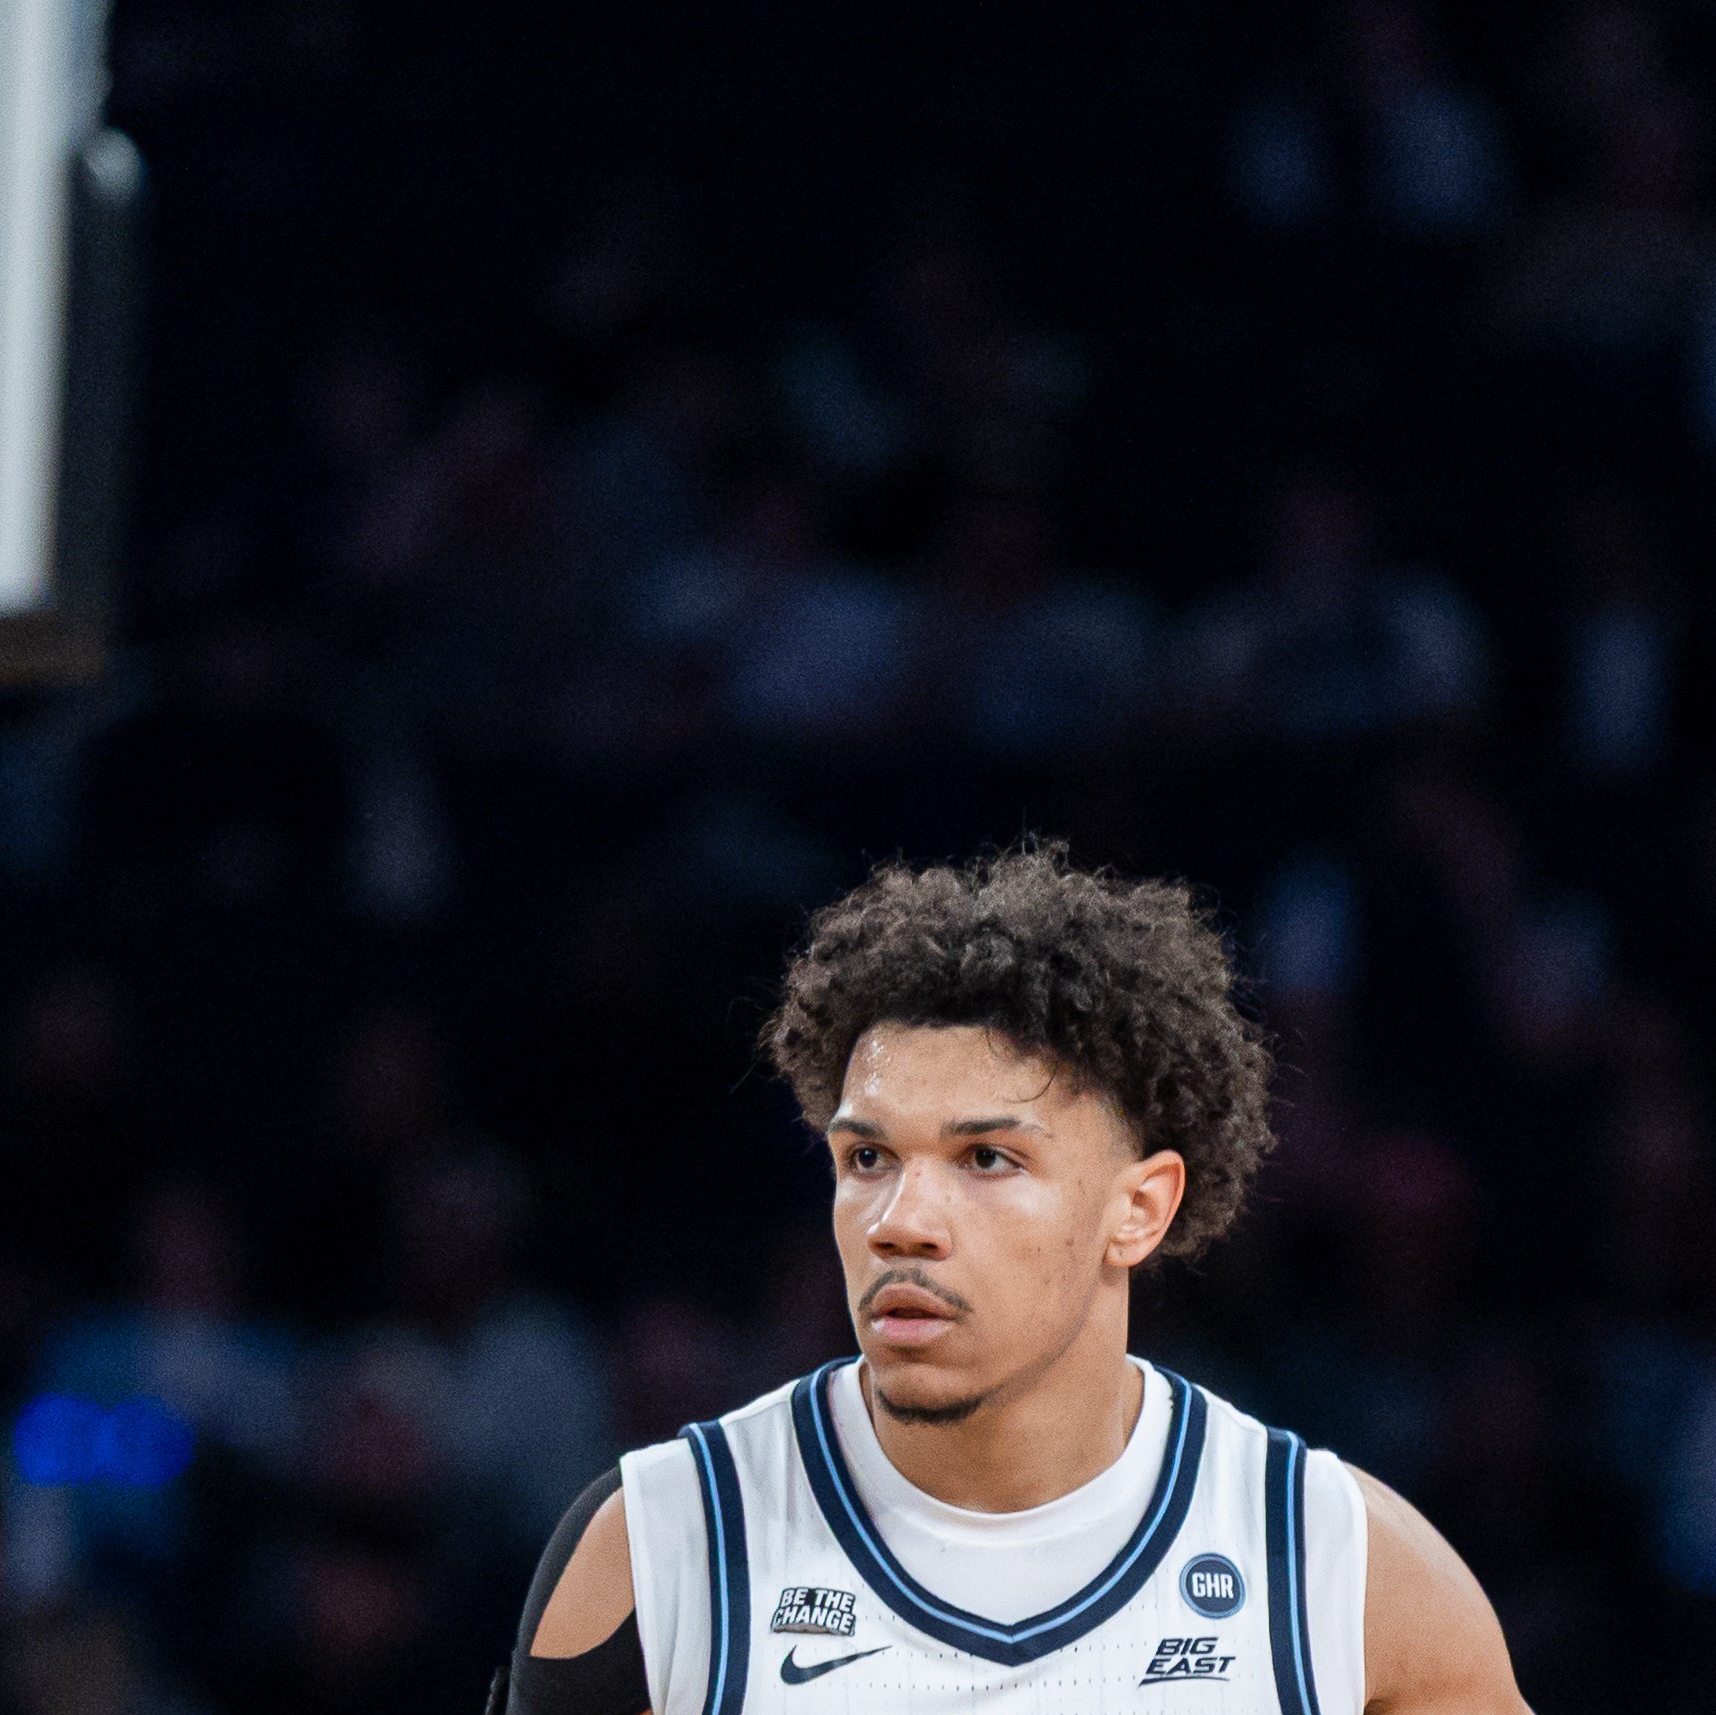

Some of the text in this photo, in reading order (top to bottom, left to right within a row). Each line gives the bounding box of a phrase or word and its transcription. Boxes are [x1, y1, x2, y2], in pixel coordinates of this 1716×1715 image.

[1191, 1571, 1234, 1599] GHR
[780, 1588, 855, 1613] BE THE
[771, 1604, 855, 1634] CHANGE
[1155, 1636, 1219, 1656] BIG
[1145, 1656, 1237, 1676] EAST
